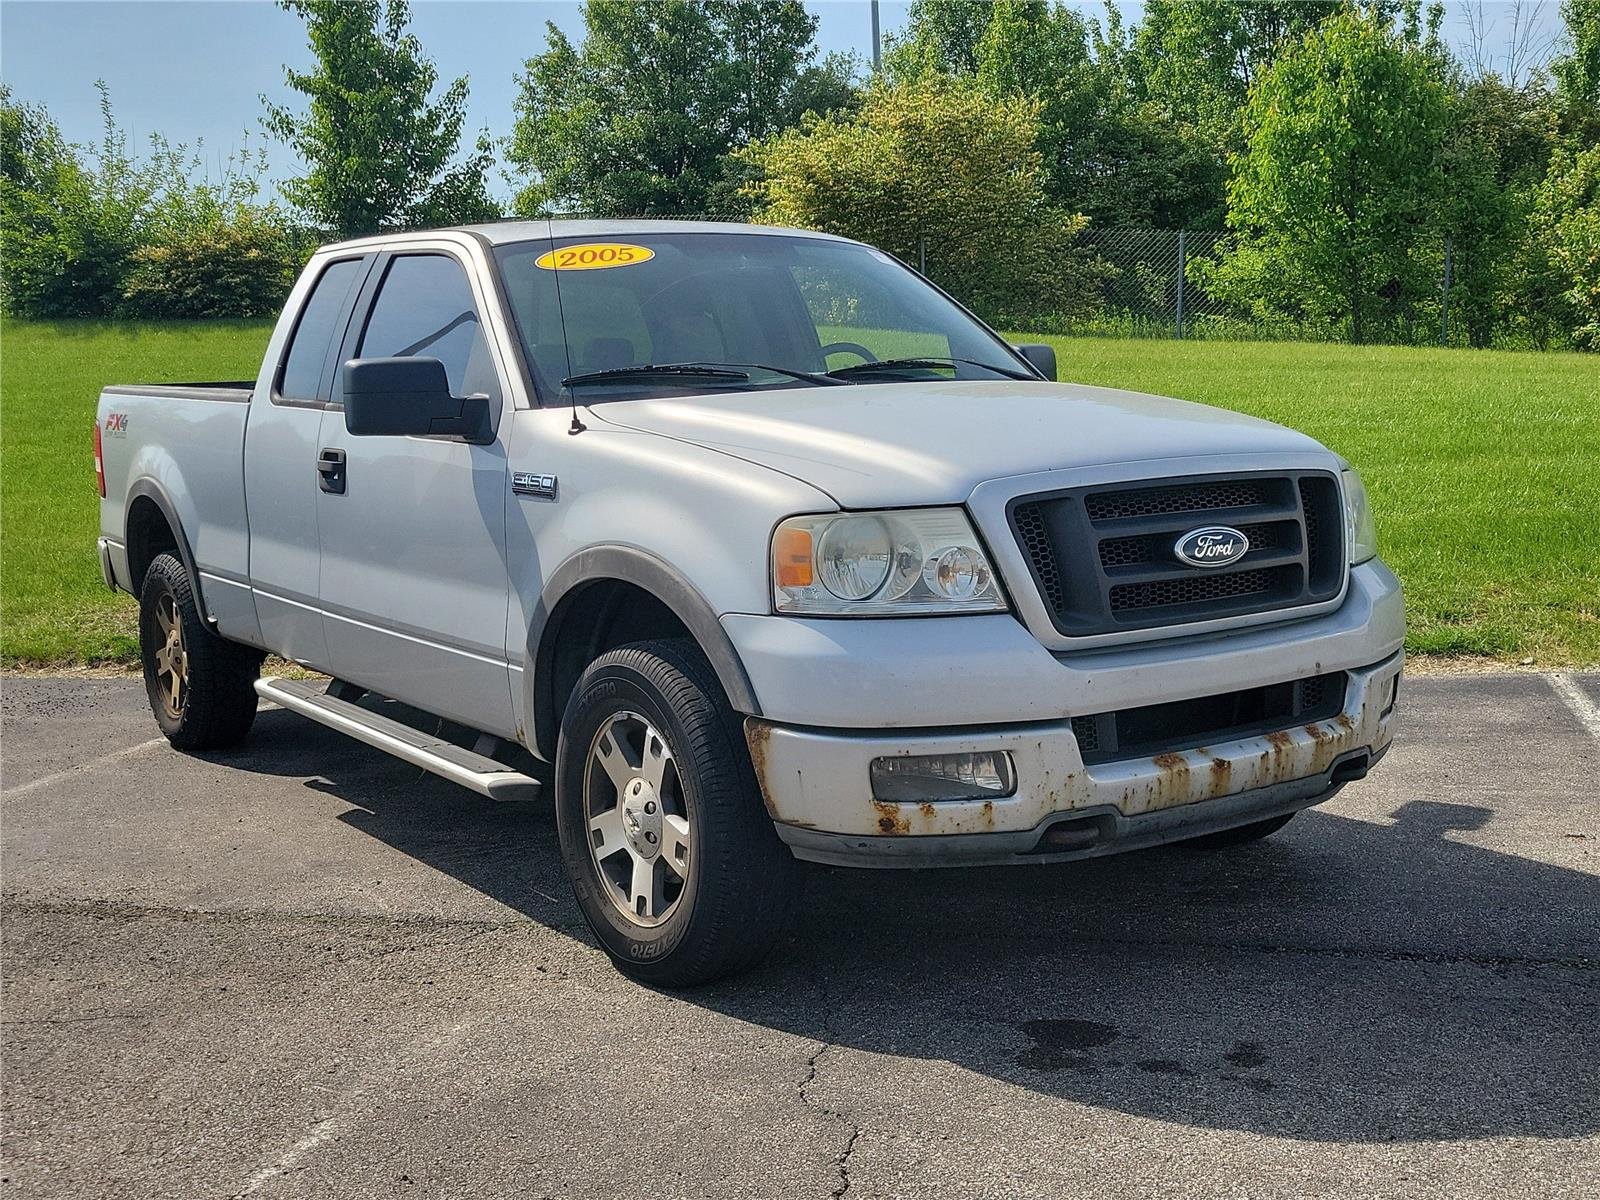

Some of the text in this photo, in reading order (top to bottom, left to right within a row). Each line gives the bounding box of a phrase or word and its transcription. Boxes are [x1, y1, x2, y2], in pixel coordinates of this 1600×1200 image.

[559, 247, 635, 268] 2005
[105, 413, 129, 432] FX4
[1194, 534, 1235, 558] Ford
